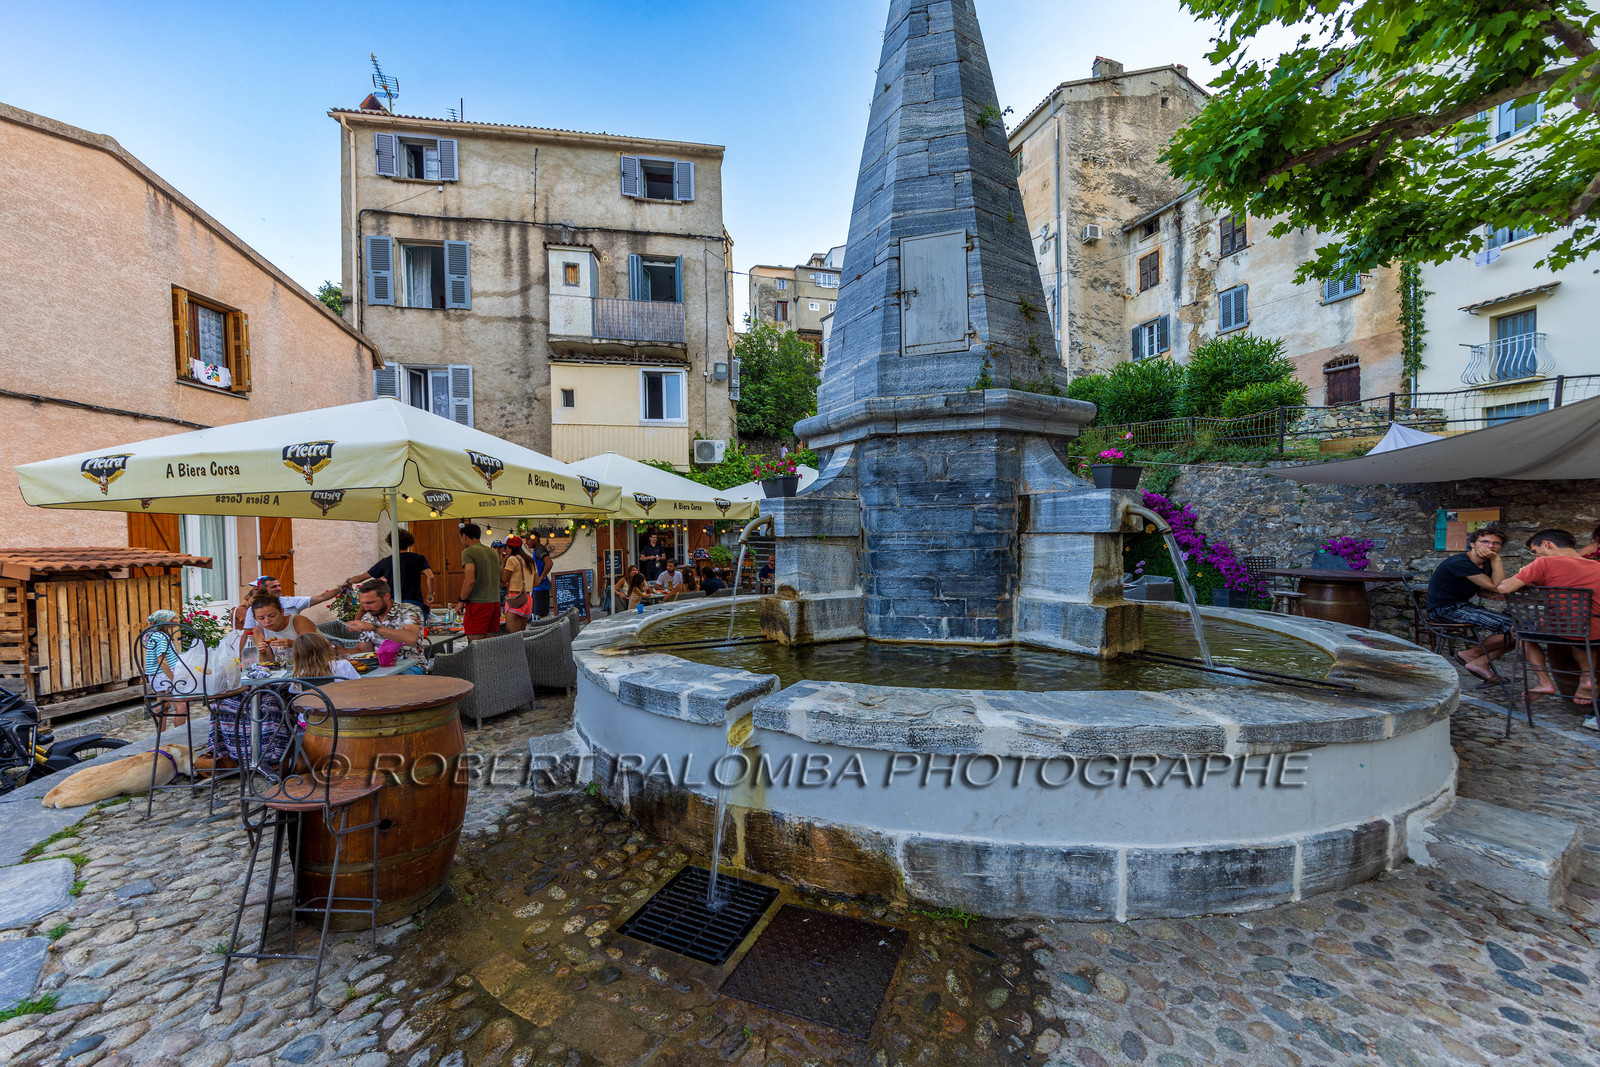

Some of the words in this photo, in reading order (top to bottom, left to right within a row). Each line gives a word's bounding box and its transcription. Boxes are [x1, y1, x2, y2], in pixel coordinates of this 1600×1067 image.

[166, 463, 175, 479] A
[178, 462, 207, 478] Biera
[210, 461, 241, 476] Corsa
[527, 473, 534, 486] A
[534, 474, 550, 489] Biera
[550, 477, 566, 491] Corsa
[673, 502, 678, 511] A
